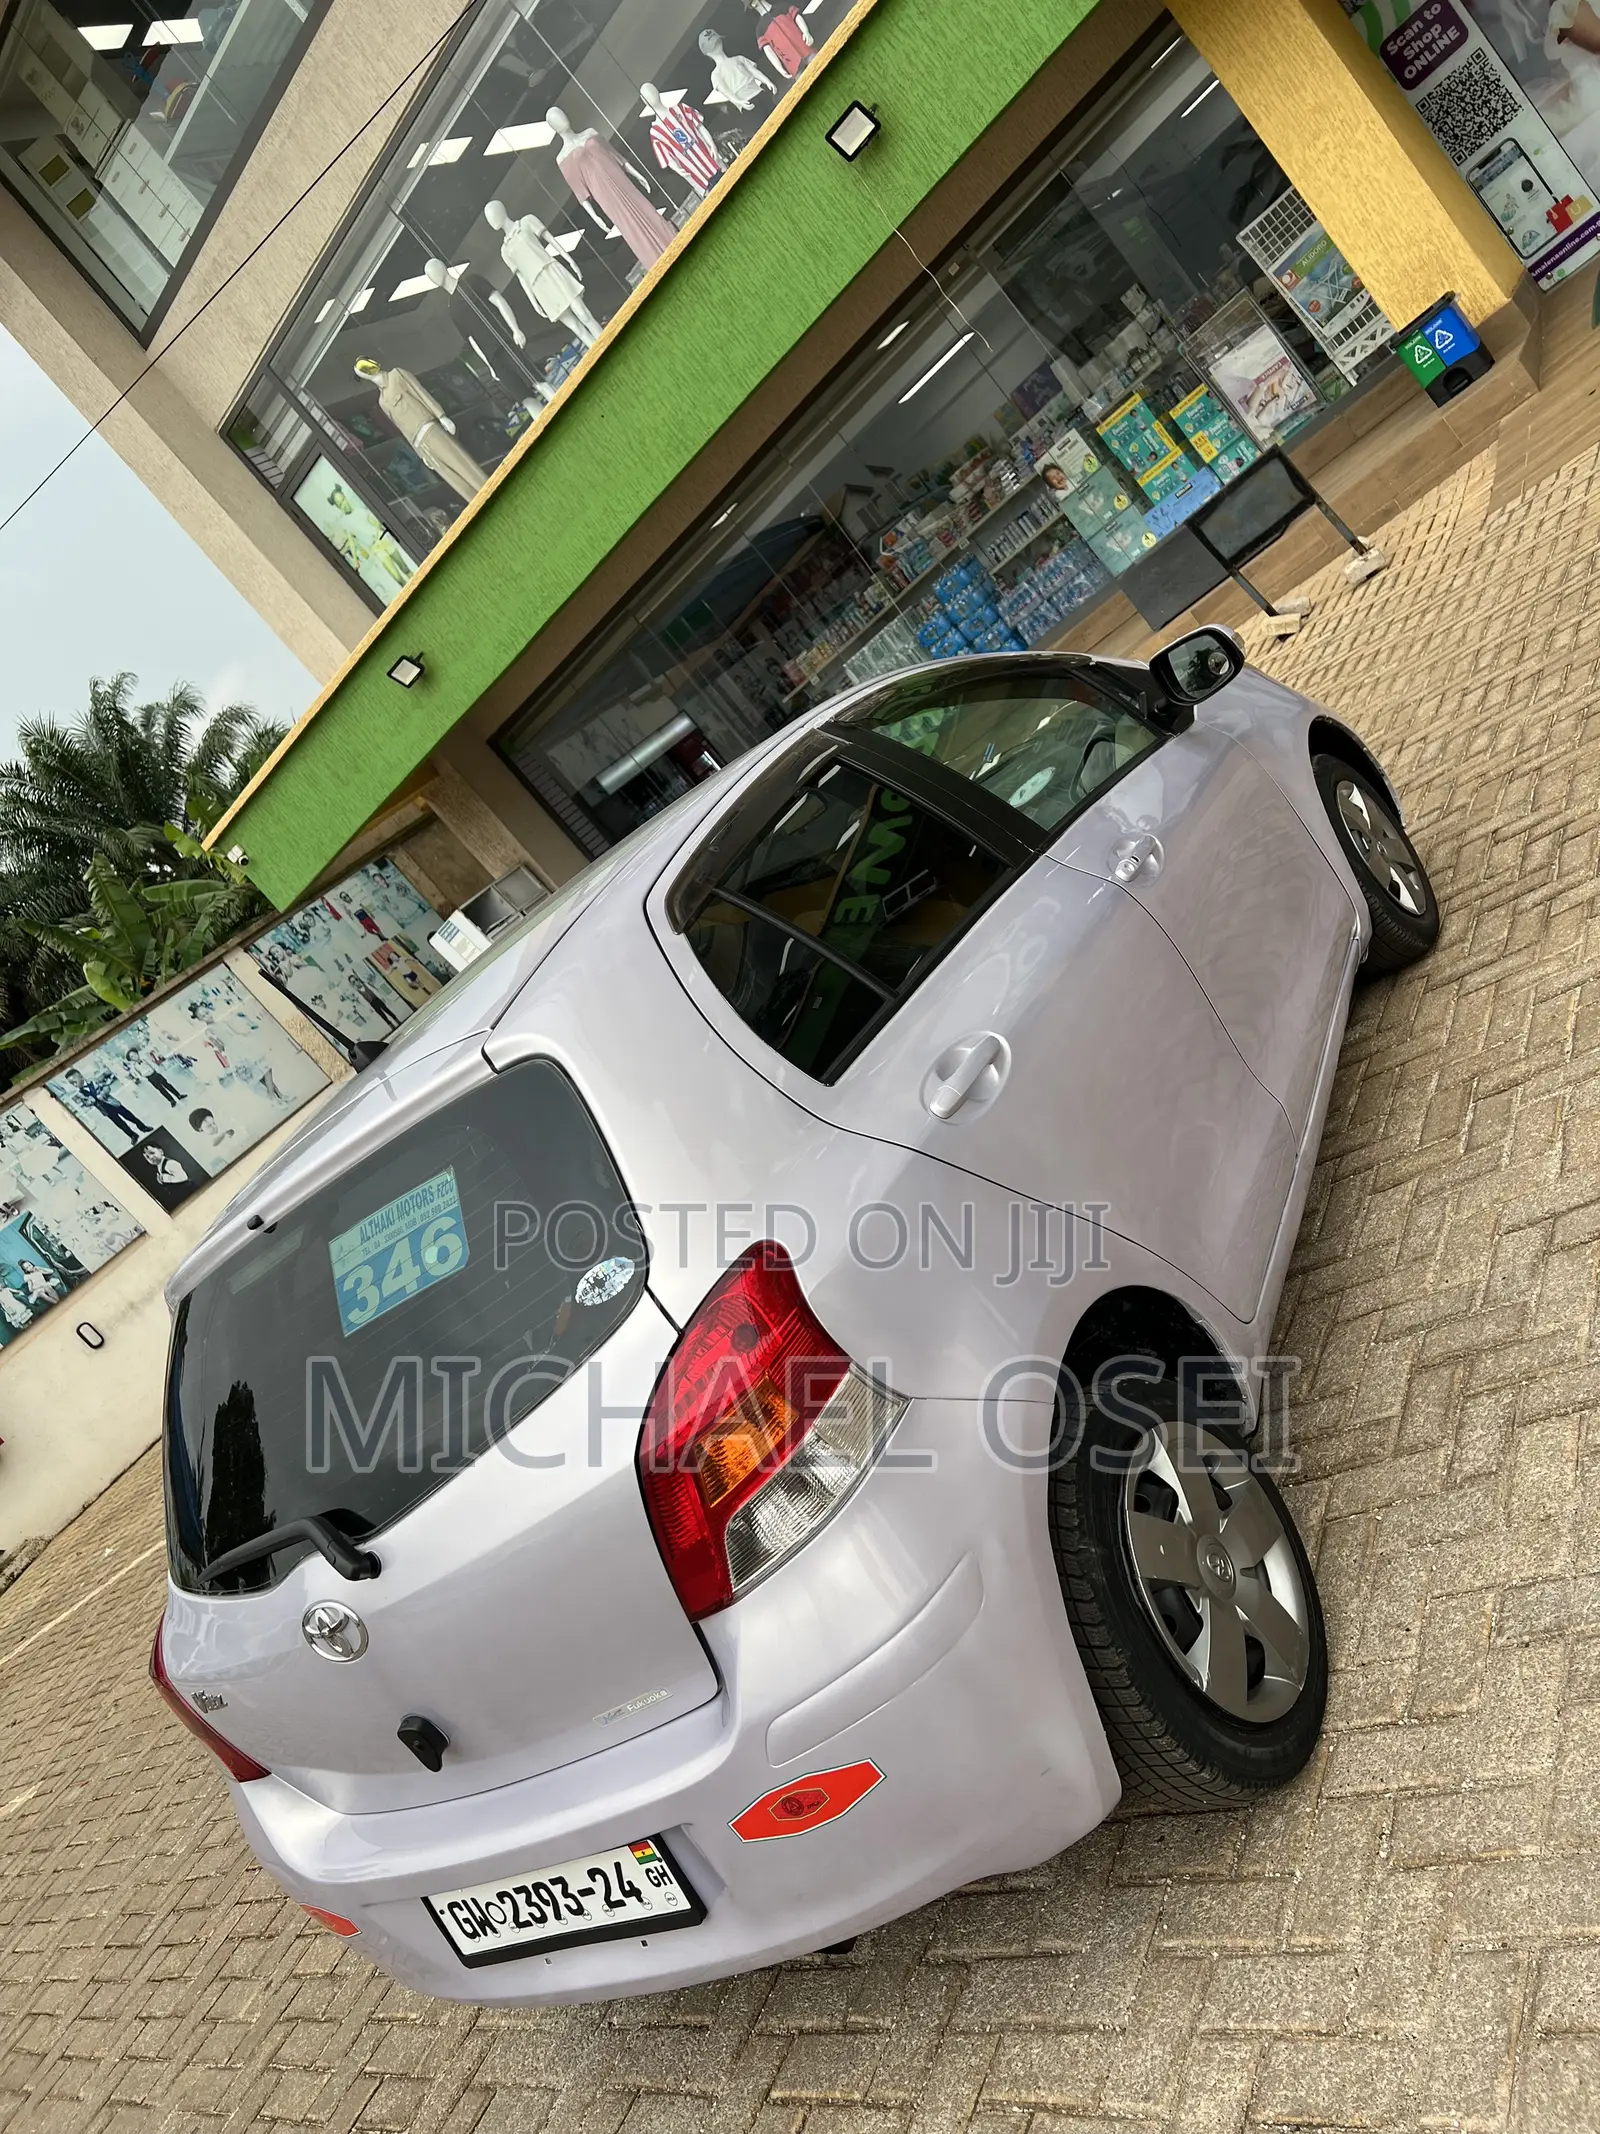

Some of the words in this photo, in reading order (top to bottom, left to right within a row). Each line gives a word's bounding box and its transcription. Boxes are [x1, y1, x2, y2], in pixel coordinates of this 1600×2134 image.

[1386, 20, 1424, 56] Scan
[1423, 3, 1442, 20] to
[1403, 23, 1442, 60] Shop
[1404, 25, 1460, 79] ONLINE
[359, 1203, 396, 1245] ALTHAKI
[396, 1185, 435, 1219] MOTORS
[343, 1216, 463, 1325] 346
[627, 1690, 668, 1712] Fukuoka
[447, 1897, 498, 1940] GW
[496, 1861, 643, 1930] 2393-24
[645, 1865, 674, 1888] GH
